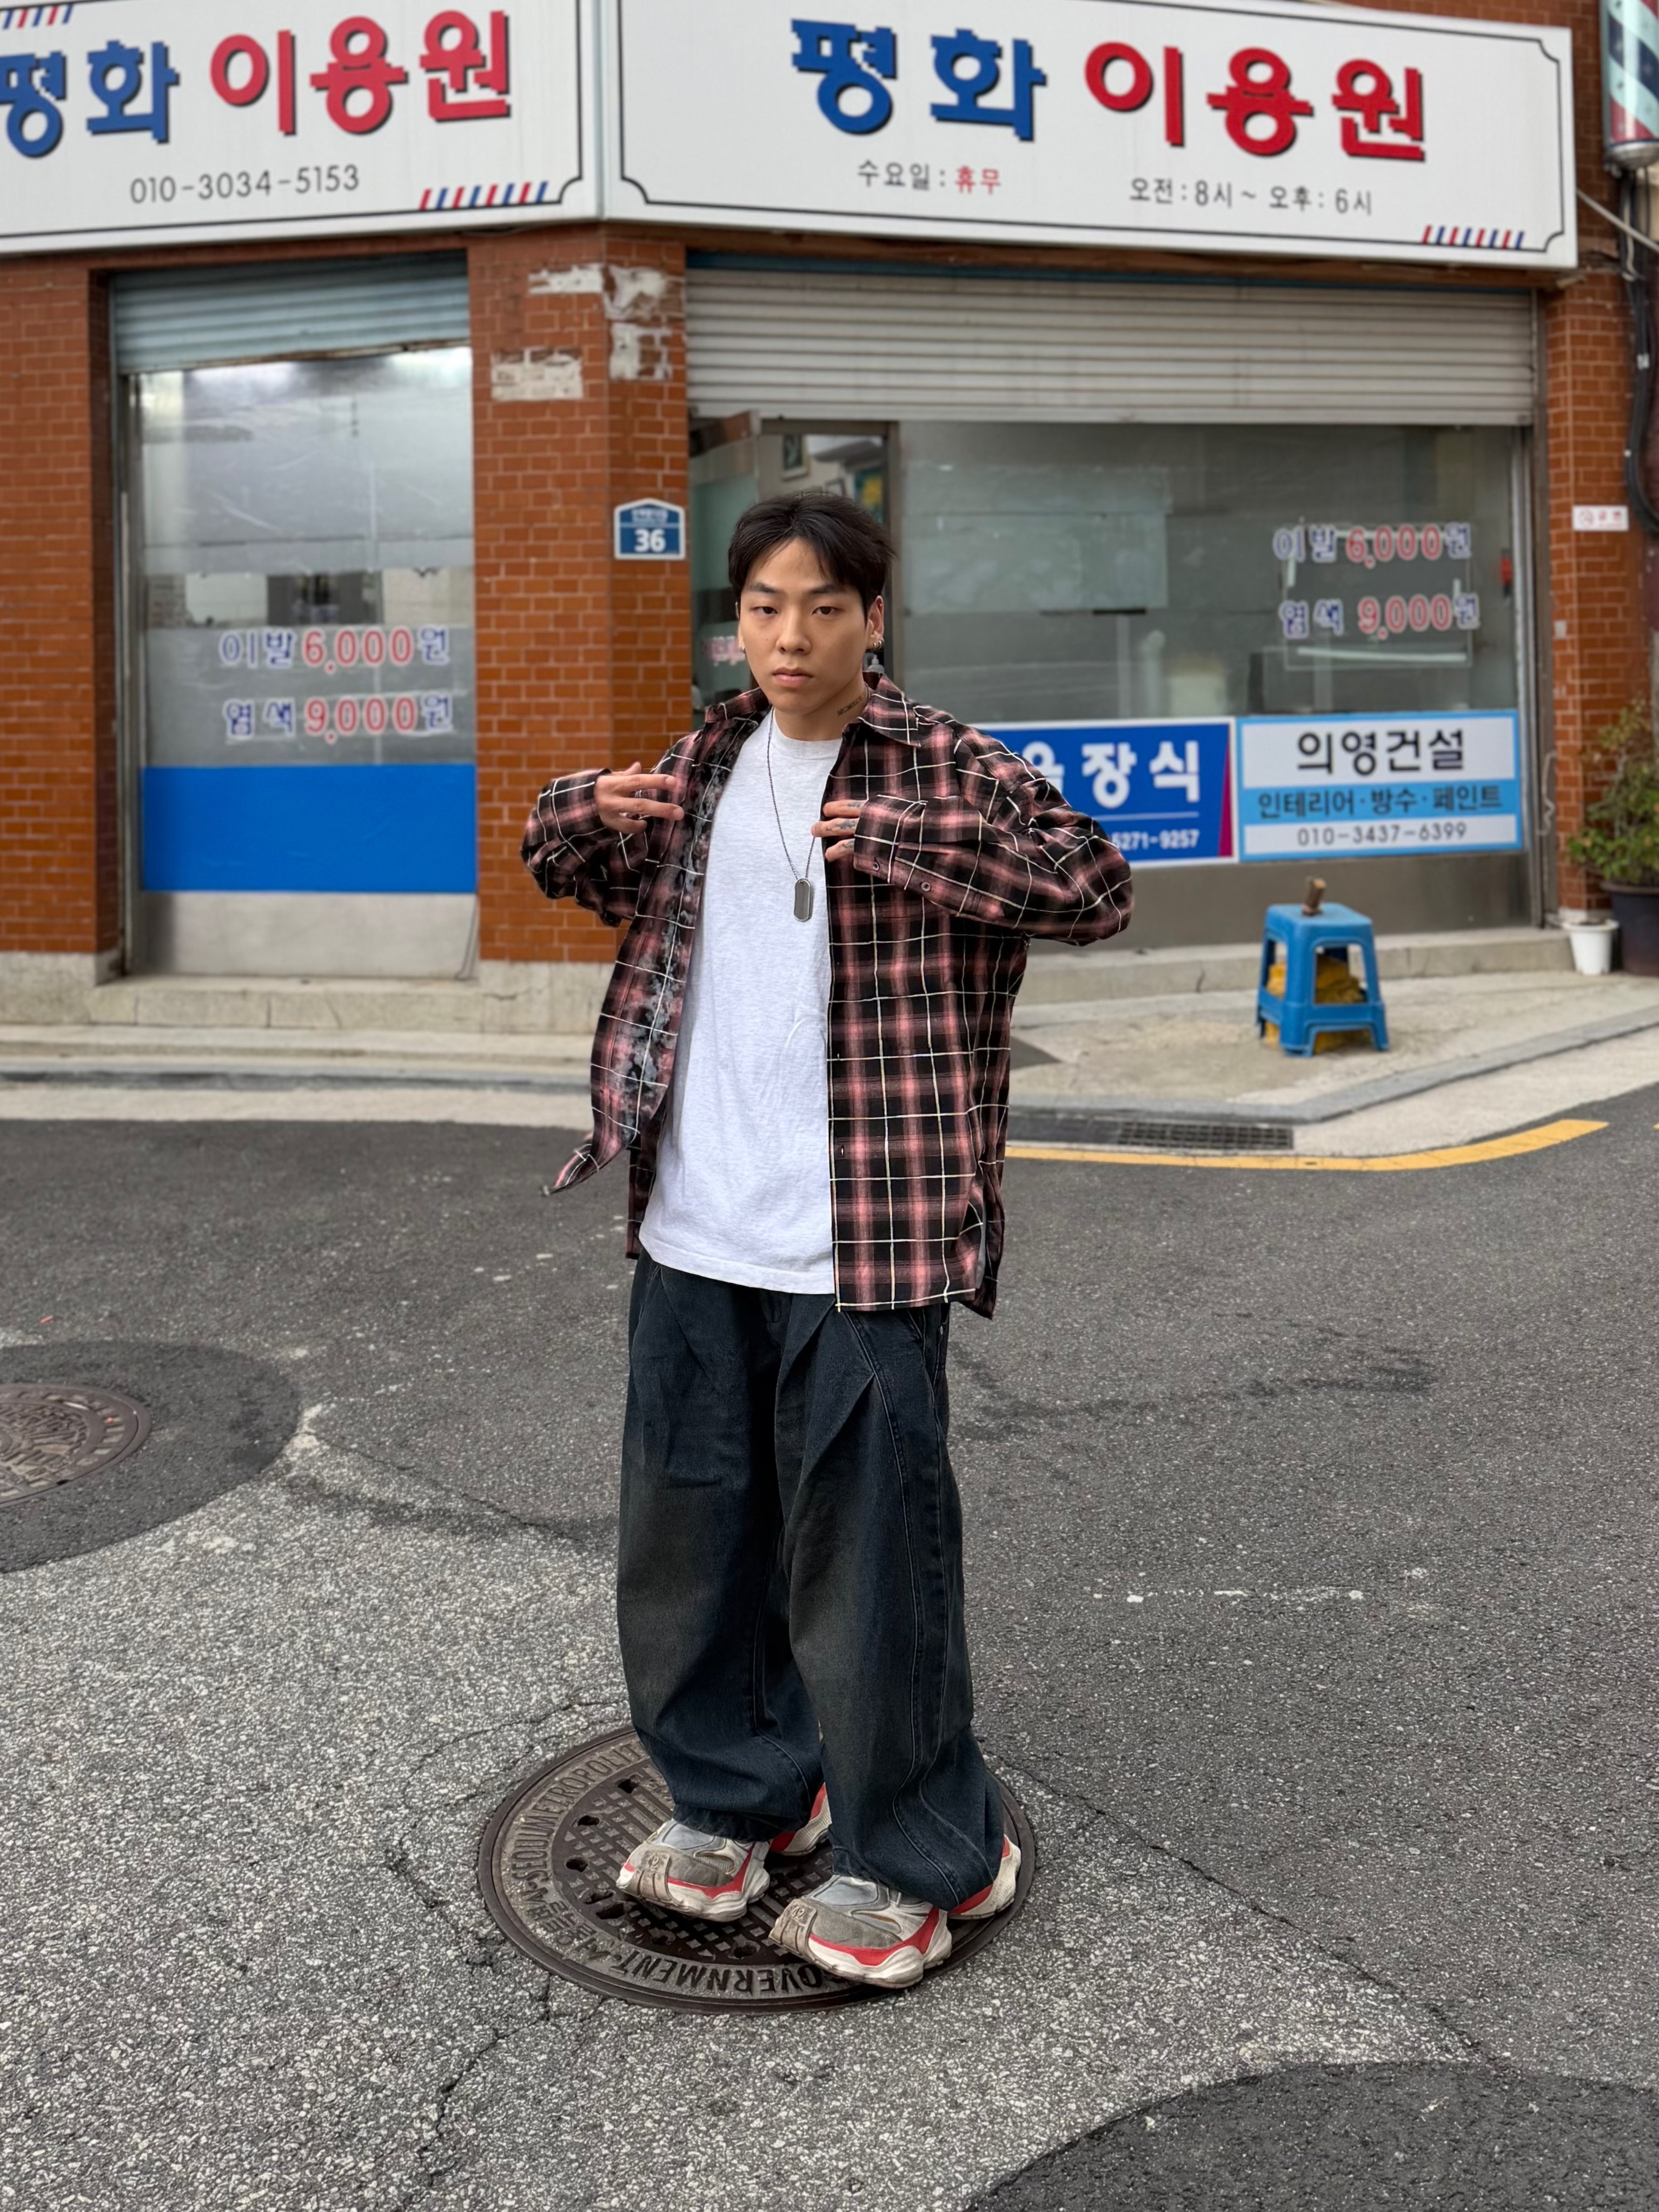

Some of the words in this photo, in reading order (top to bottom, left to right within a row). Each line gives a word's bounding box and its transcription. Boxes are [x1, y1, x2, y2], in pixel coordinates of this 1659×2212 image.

[0, 41, 181, 159] 평화
[209, 10, 510, 135] 이용원
[792, 19, 1047, 142] 평화
[1084, 41, 1425, 162] 이용원
[130, 164, 360, 204] 010-3034-5153
[635, 528, 666, 553] 36
[220, 630, 295, 668] 이발
[1297, 730, 1463, 777] 의영건설
[1298, 822, 1468, 846] 010-3437-6399
